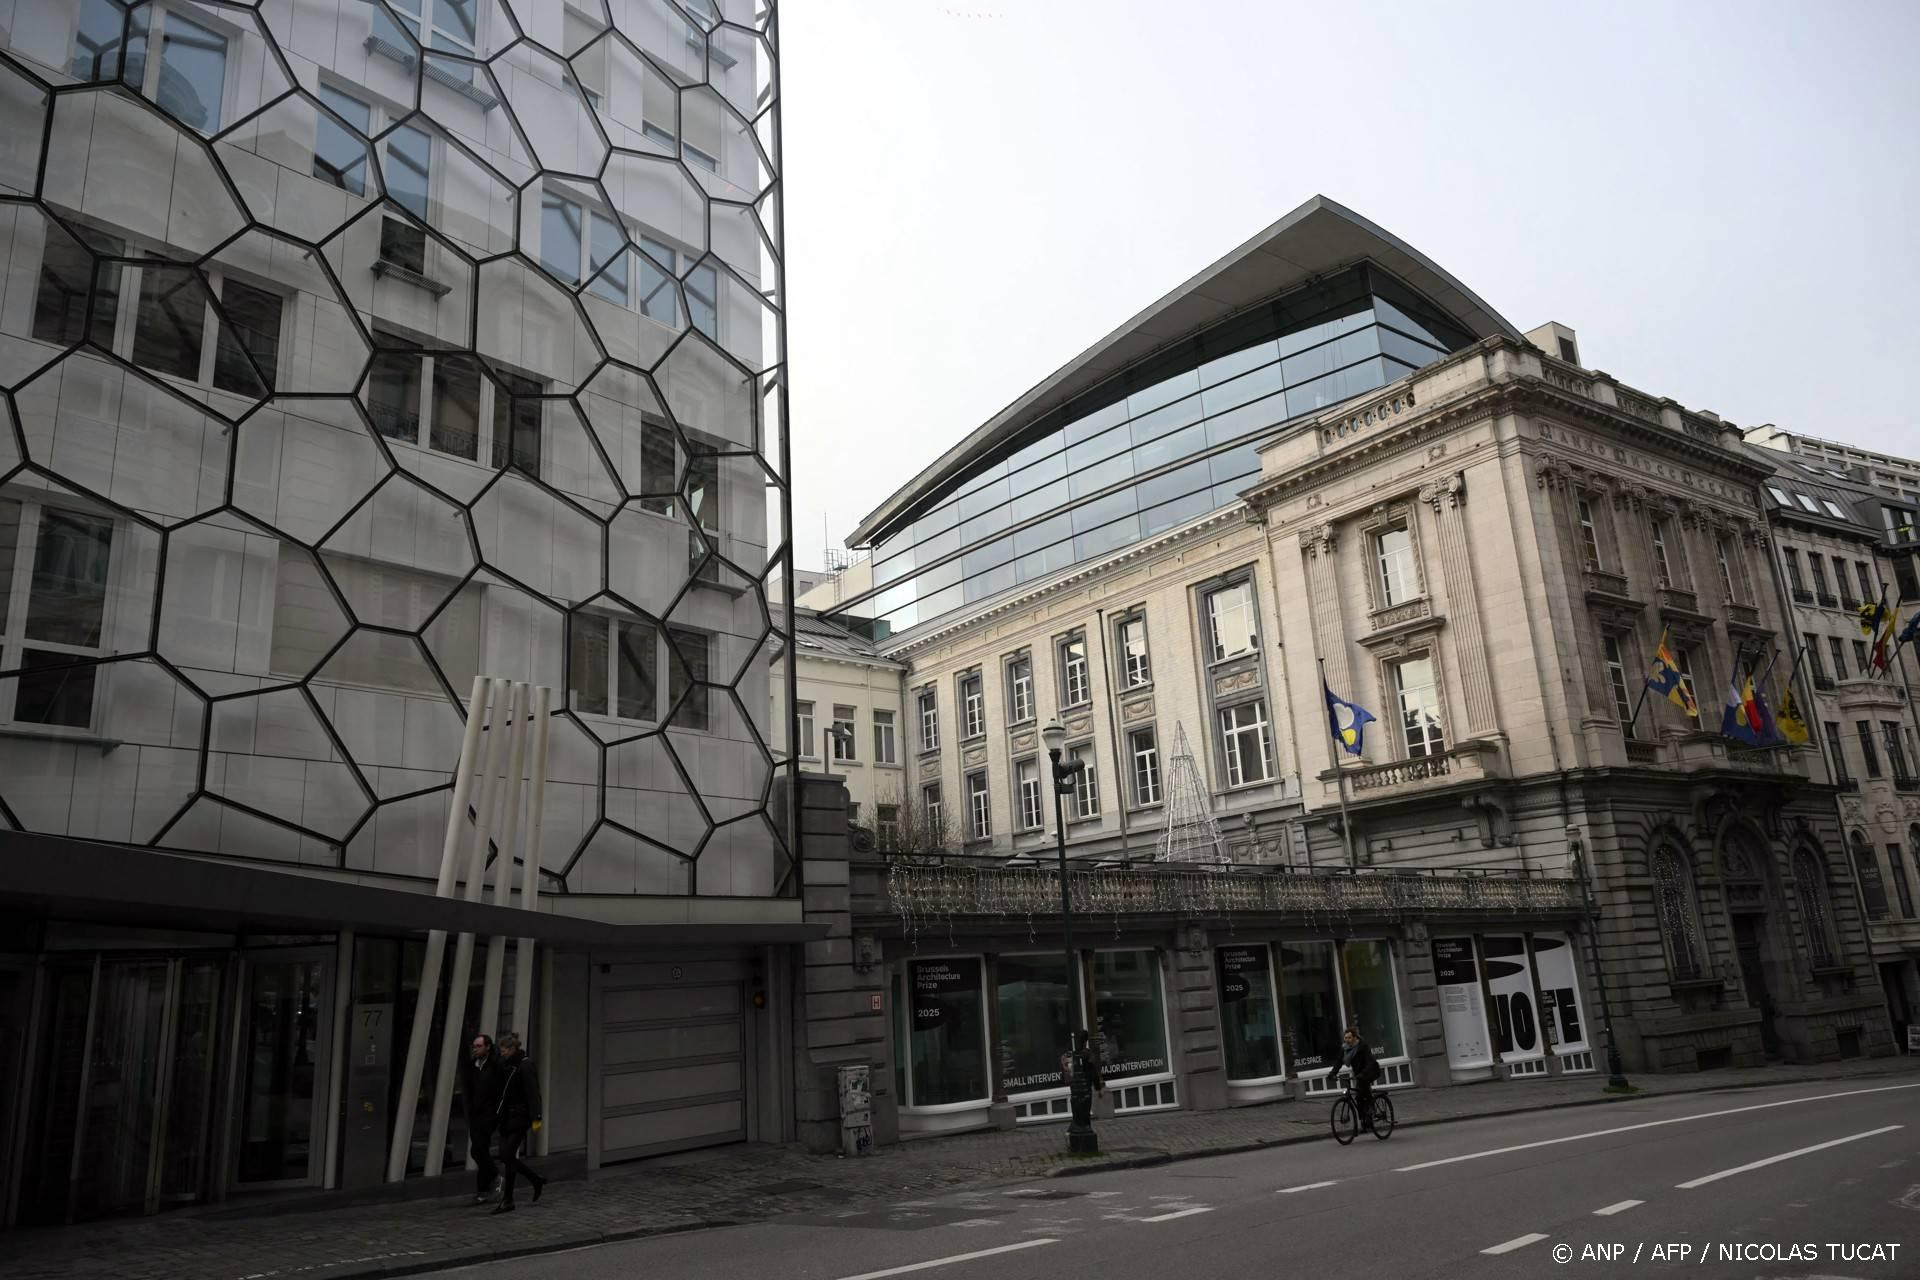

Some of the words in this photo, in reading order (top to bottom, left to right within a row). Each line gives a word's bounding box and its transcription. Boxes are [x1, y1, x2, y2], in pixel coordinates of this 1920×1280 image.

[916, 964, 950, 974] Brussels
[1440, 969, 1455, 977] 2025
[917, 982, 938, 990] Prize
[1226, 984, 1244, 992] 2025
[918, 1008, 940, 1018] 2025
[363, 1010, 383, 1027] 77
[1121, 1057, 1164, 1073] INTERVENTION
[1003, 1076, 1027, 1088] SMALL
